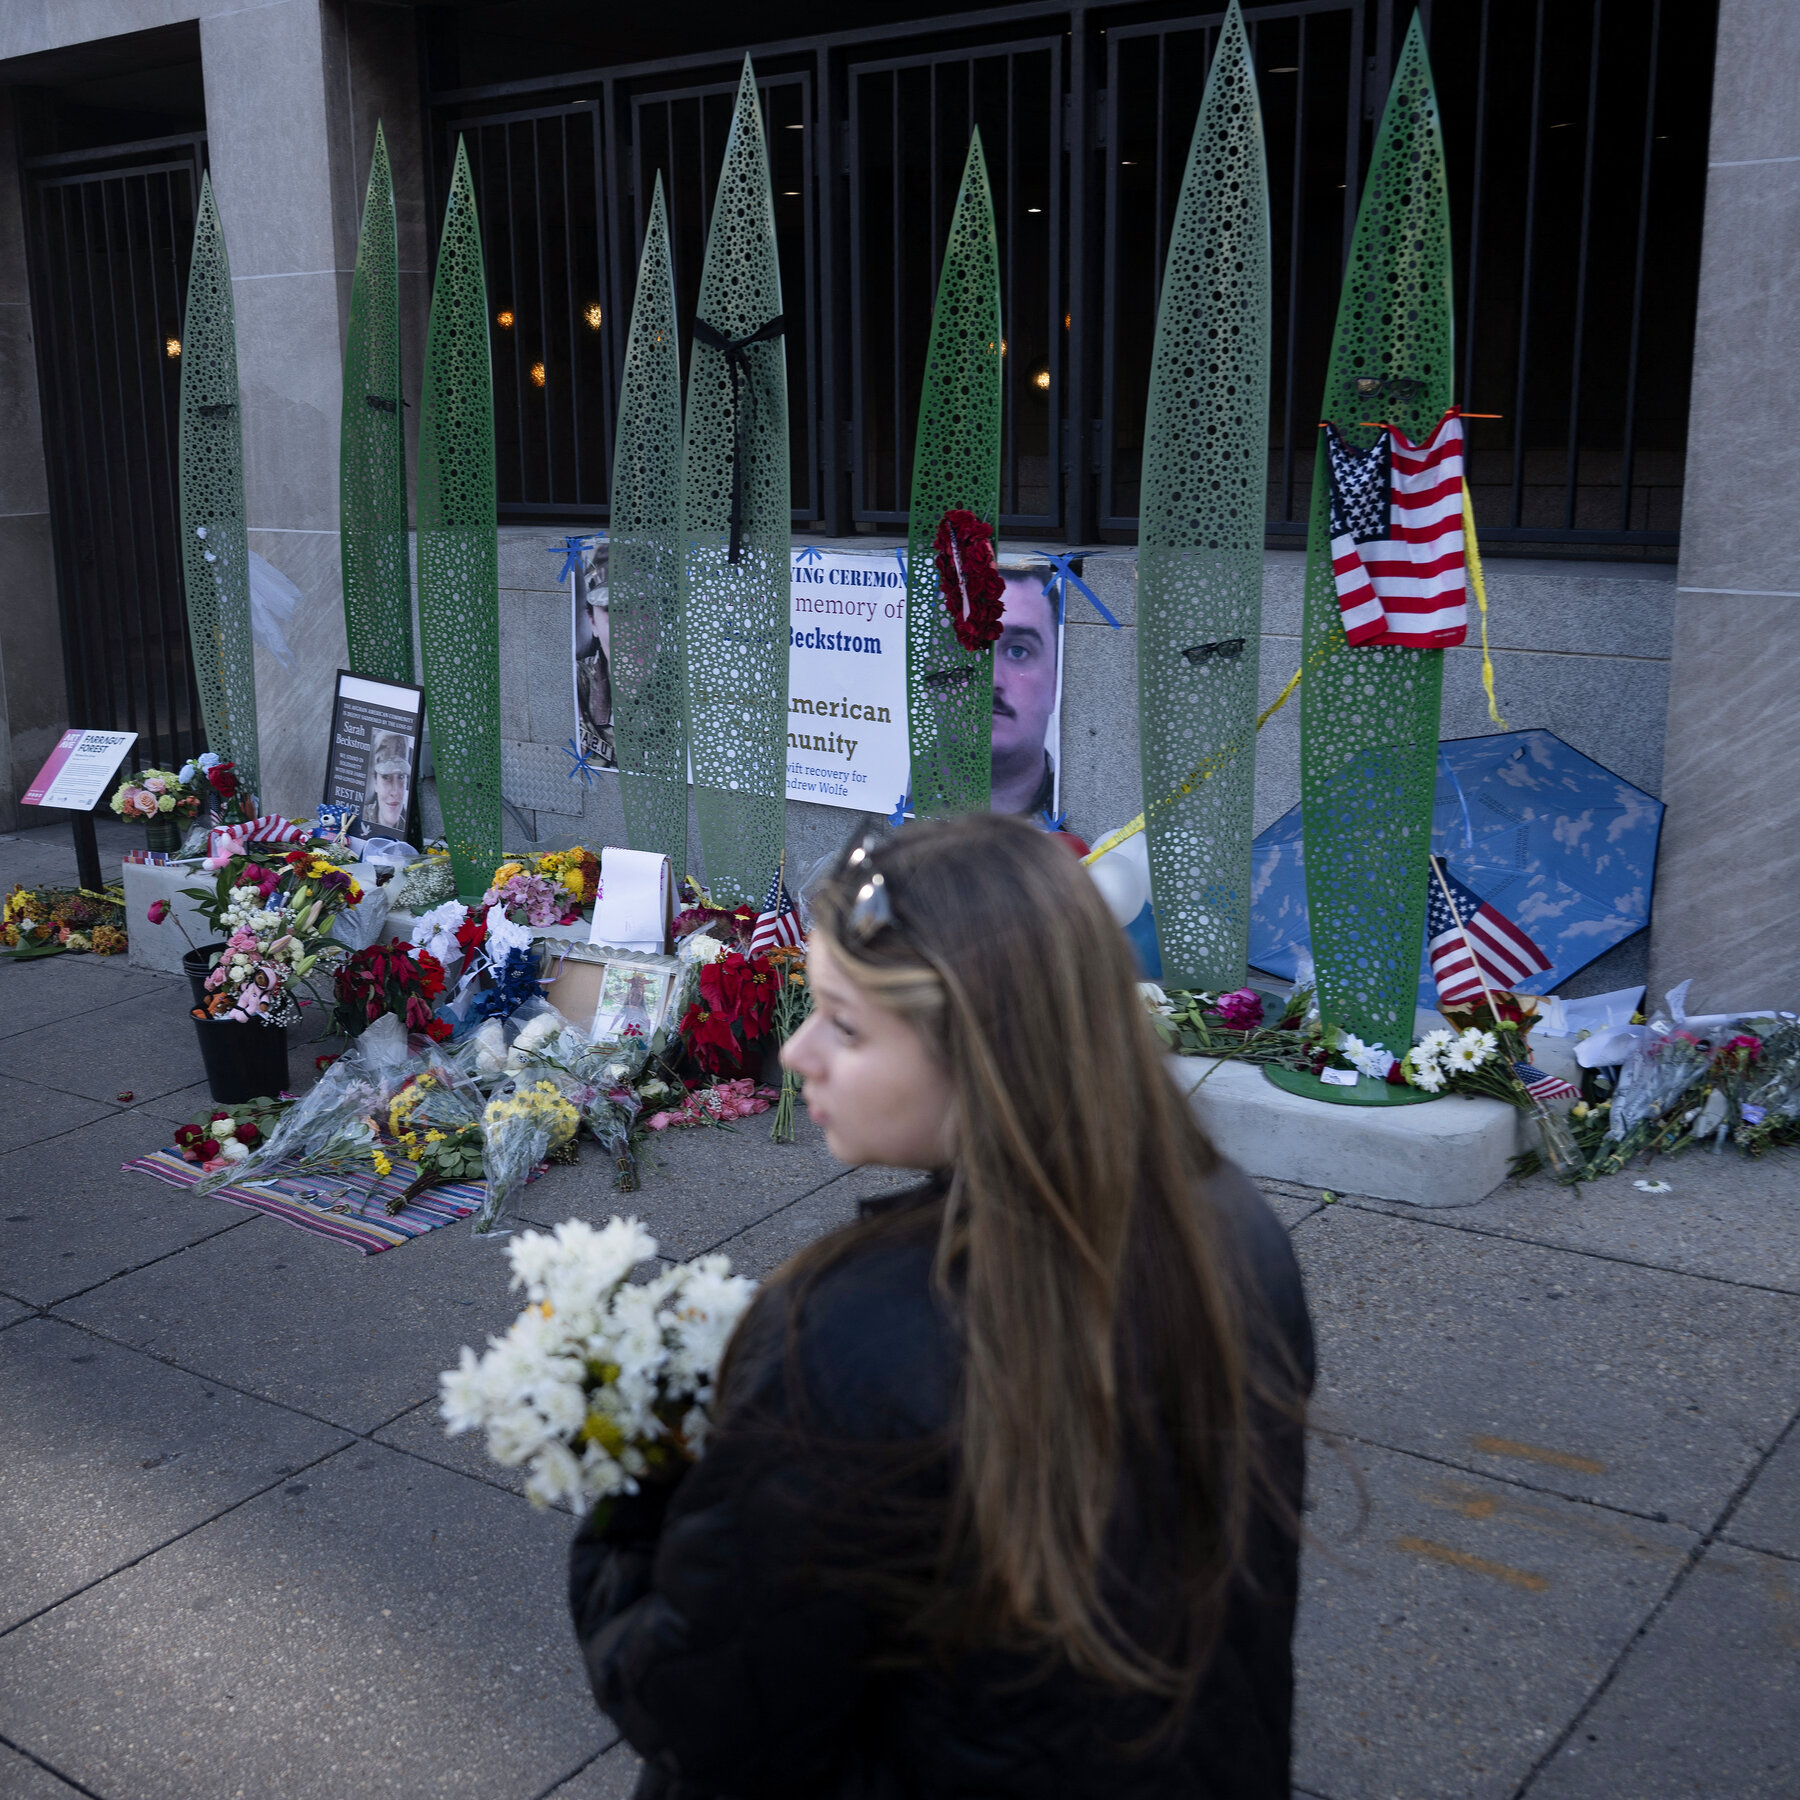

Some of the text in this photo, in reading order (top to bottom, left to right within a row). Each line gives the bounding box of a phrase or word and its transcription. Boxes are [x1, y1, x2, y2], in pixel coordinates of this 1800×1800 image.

[795, 596, 877, 622] memory
[884, 598, 905, 619] of
[788, 696, 892, 724] merican
[343, 720, 366, 737] Sarah
[58, 741, 76, 749] AVE
[63, 733, 81, 742] ART
[83, 735, 127, 745] FARRAGUT
[335, 733, 371, 752] Beckstrom
[76, 744, 109, 753] FOREST
[804, 765, 850, 782] recovery
[851, 770, 868, 784] for
[334, 786, 365, 802] REST IN
[818, 781, 849, 797] Wolfe
